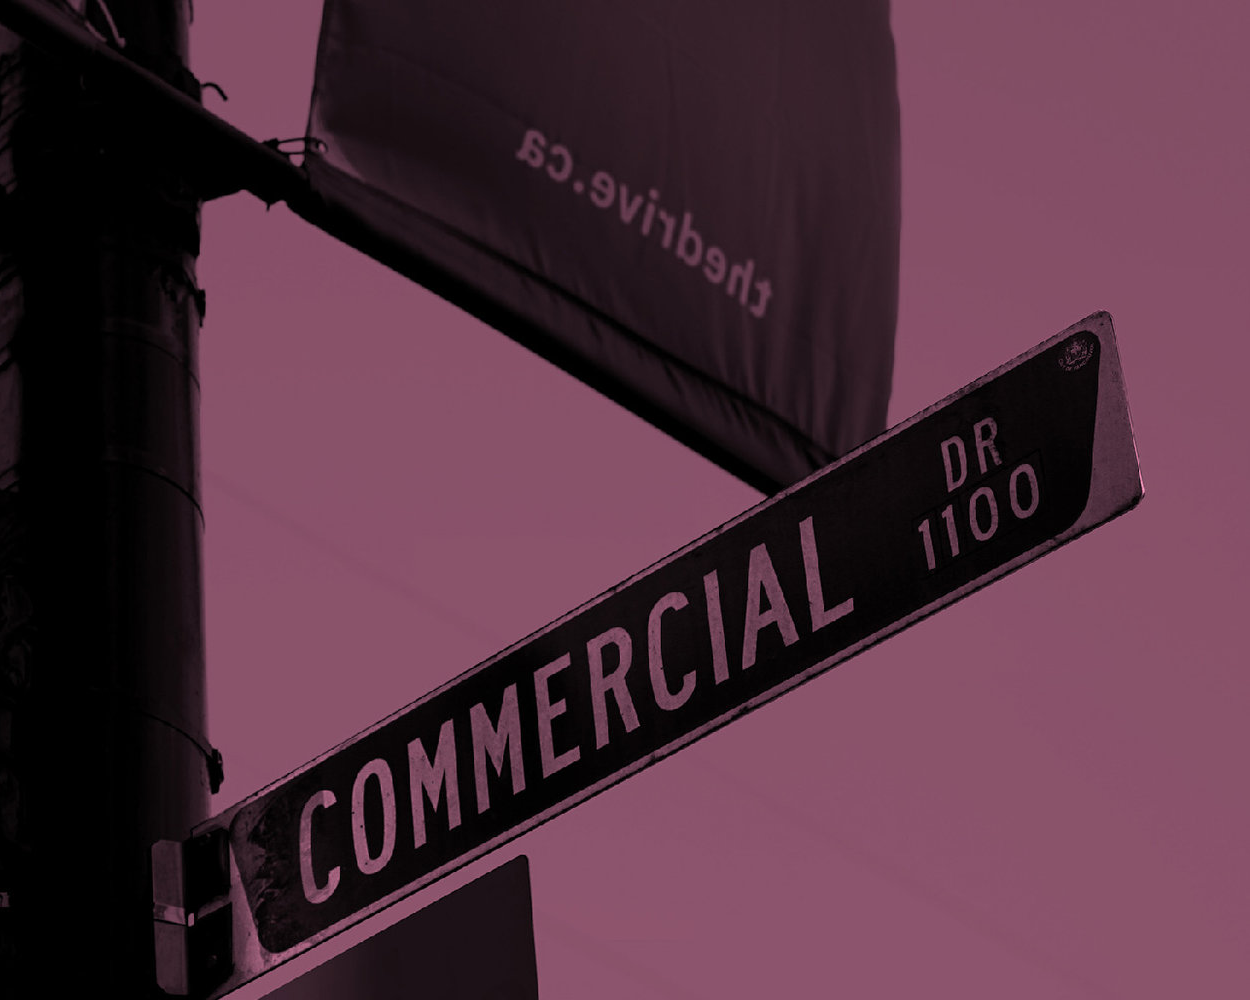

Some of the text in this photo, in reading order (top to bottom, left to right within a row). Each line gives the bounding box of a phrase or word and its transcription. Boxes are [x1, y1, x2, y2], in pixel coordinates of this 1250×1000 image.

[940, 416, 1003, 493] DR
[917, 462, 1040, 571] 1100
[299, 516, 855, 904] COMMERCIAL
